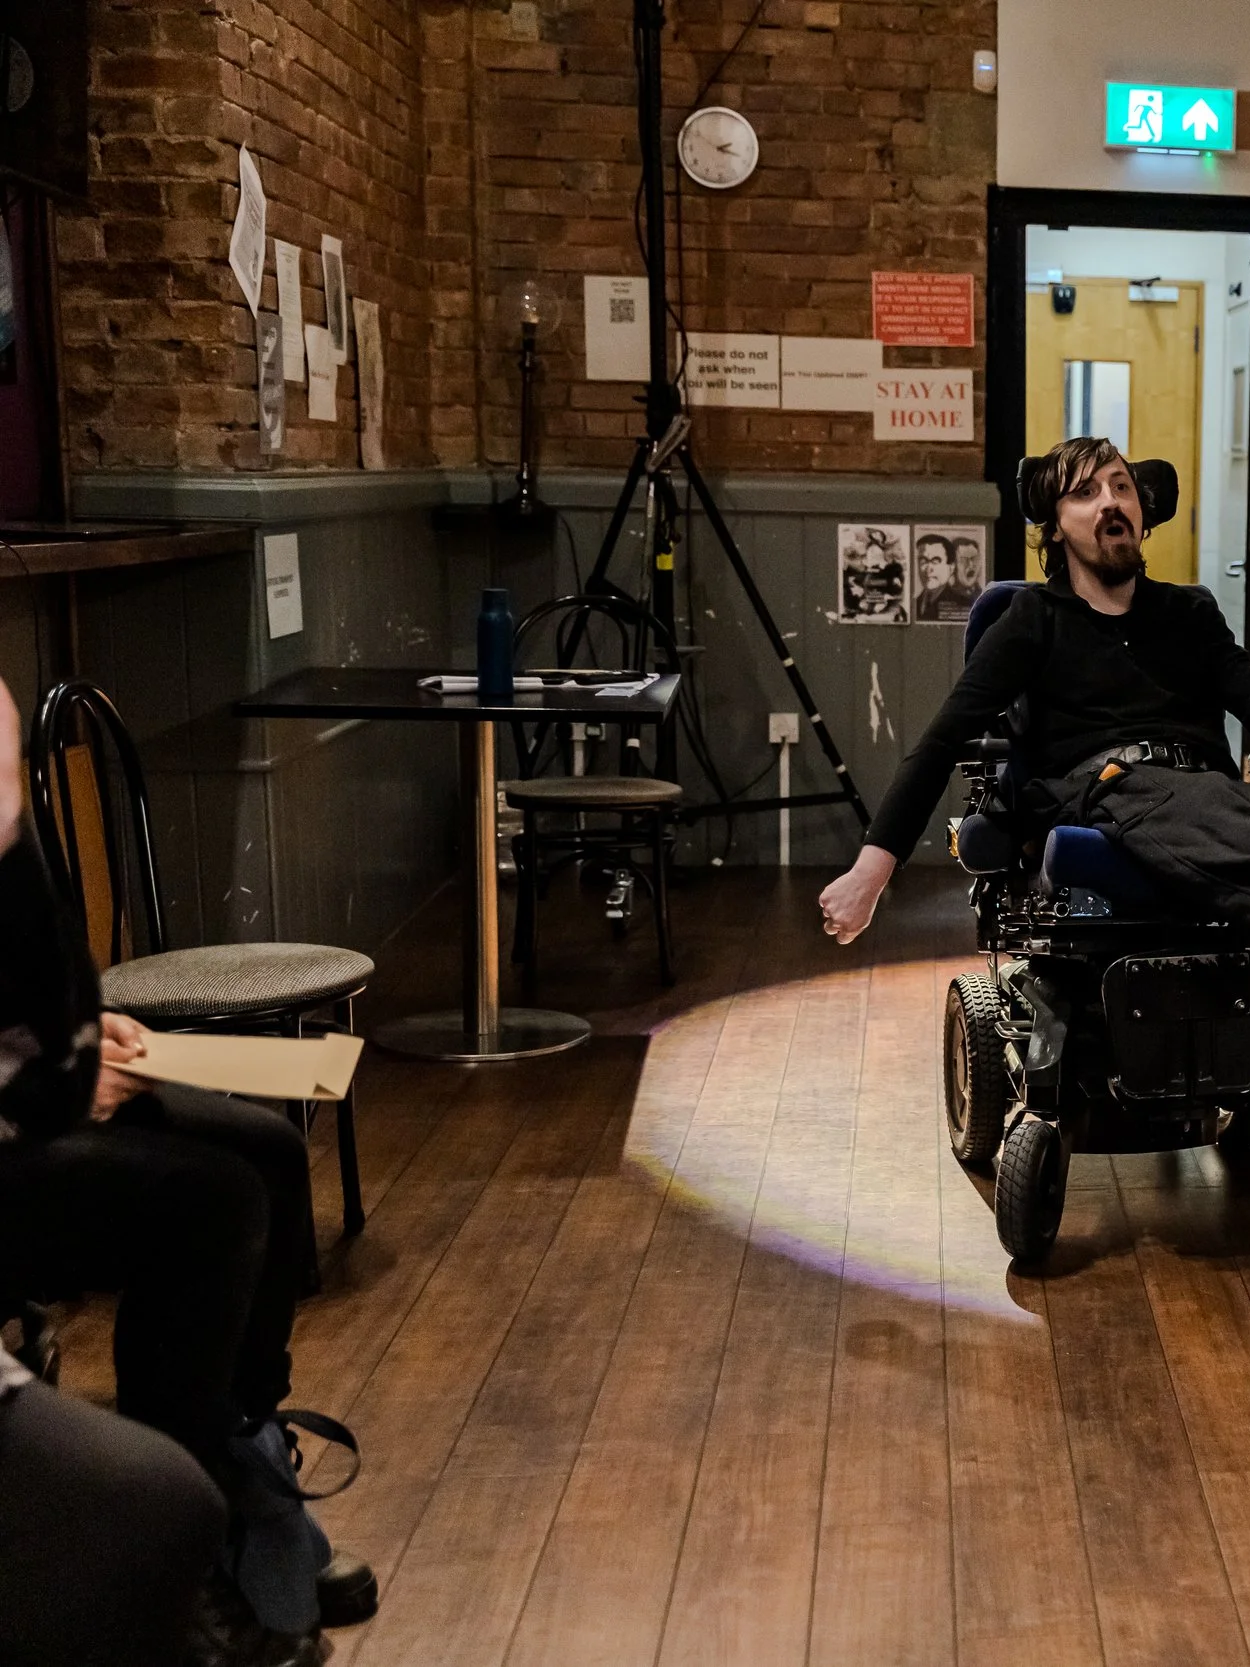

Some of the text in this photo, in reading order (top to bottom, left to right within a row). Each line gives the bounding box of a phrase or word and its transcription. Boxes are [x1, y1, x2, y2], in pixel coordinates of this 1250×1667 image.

[932, 306, 968, 314] CONTACT
[687, 347, 768, 360] Please do not
[699, 364, 756, 374] ask when
[706, 380, 727, 389] will
[730, 380, 745, 389] be
[749, 382, 778, 391] seen
[877, 380, 969, 401] STAY AT
[890, 409, 964, 429] HOME
